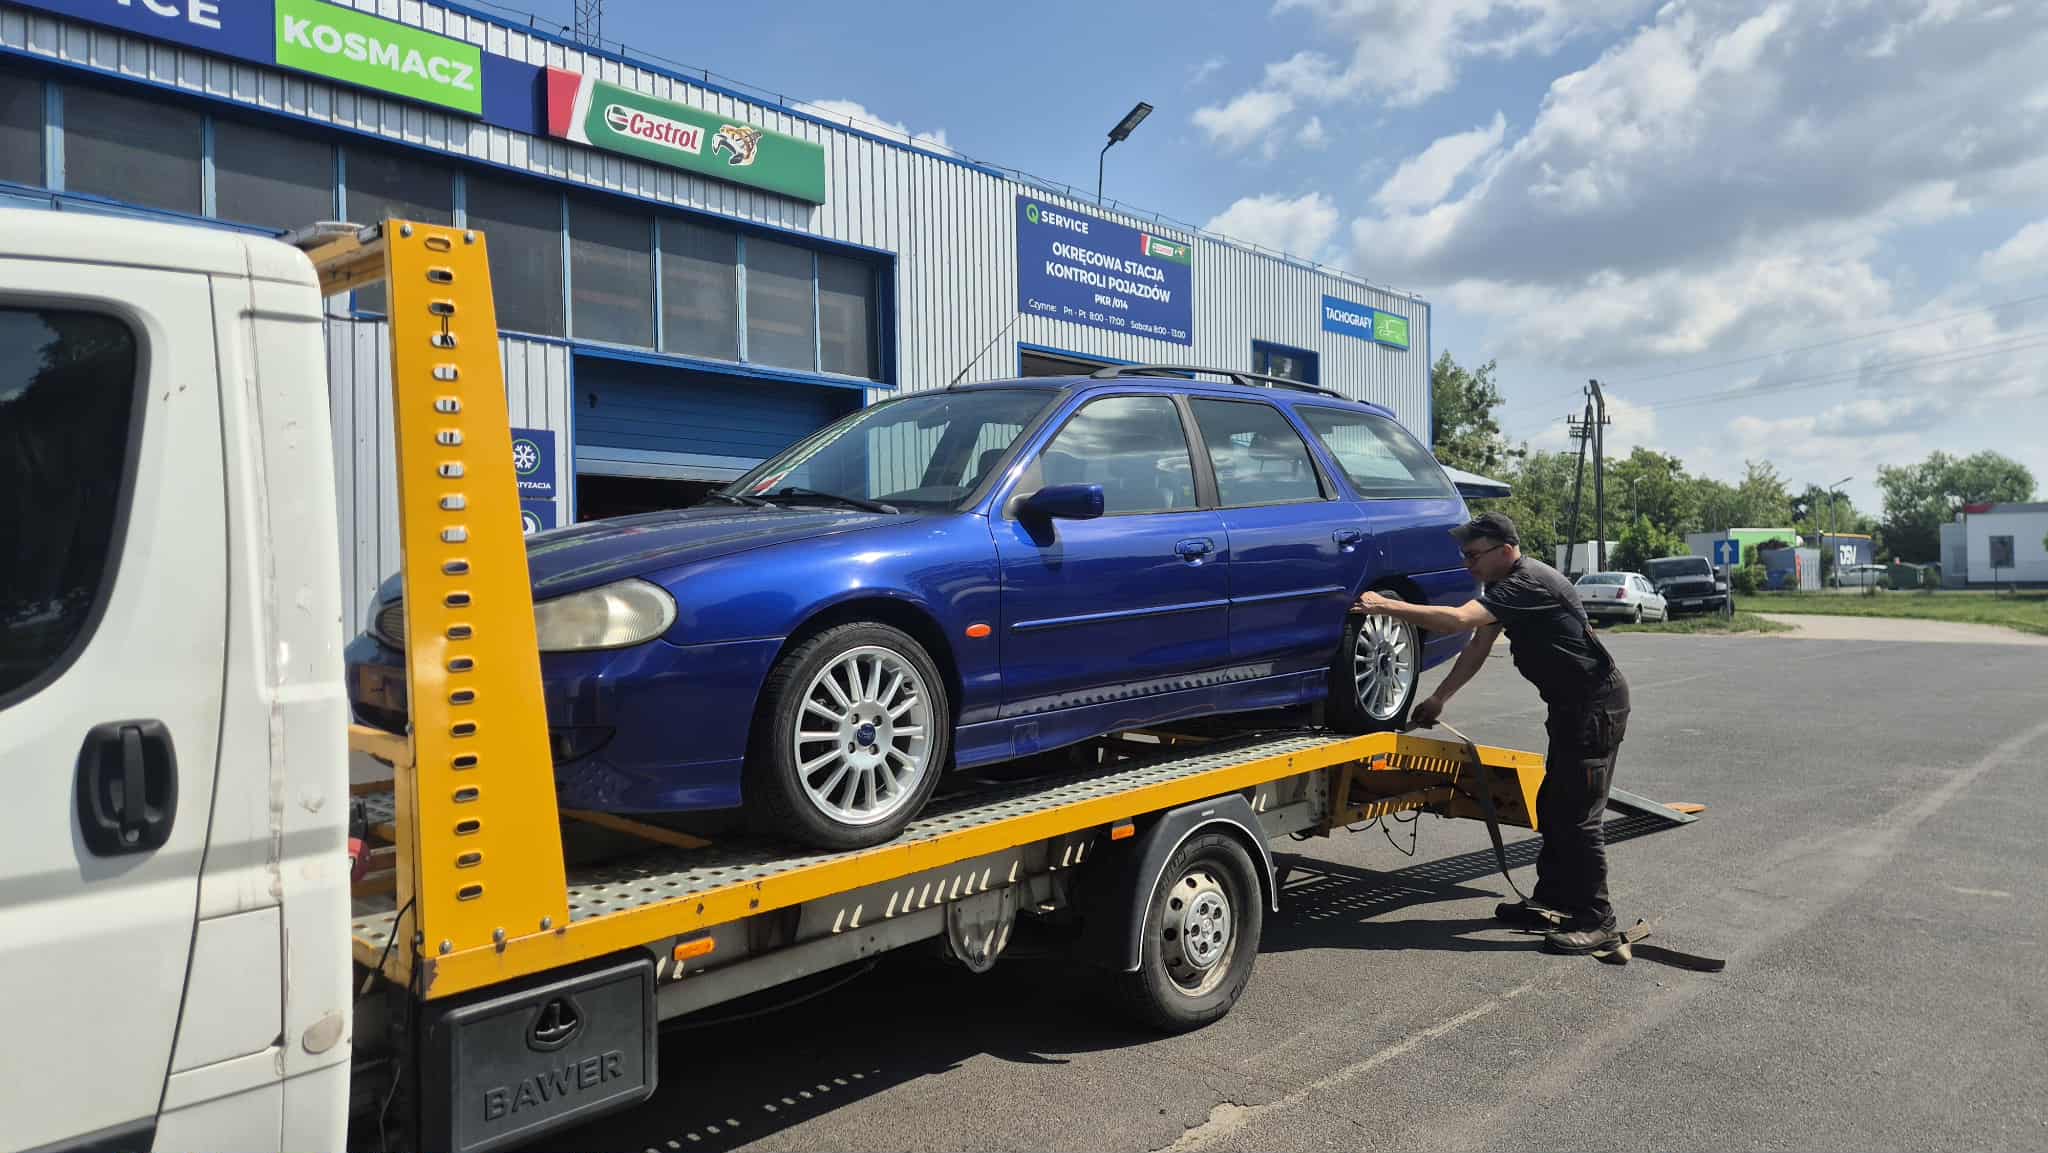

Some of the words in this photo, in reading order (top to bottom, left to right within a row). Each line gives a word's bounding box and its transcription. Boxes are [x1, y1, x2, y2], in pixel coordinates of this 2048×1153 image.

[283, 15, 475, 91] KOSMACZ
[629, 113, 698, 150] Castrol
[1041, 210, 1089, 235] SERVICE
[1046, 260, 1107, 289] KONTROLI
[1108, 276, 1171, 304] POJAZDÓW
[1052, 241, 1122, 272] OKRĘGOWA
[1124, 260, 1165, 283] STACJA
[484, 1049, 624, 1122] BAWER
